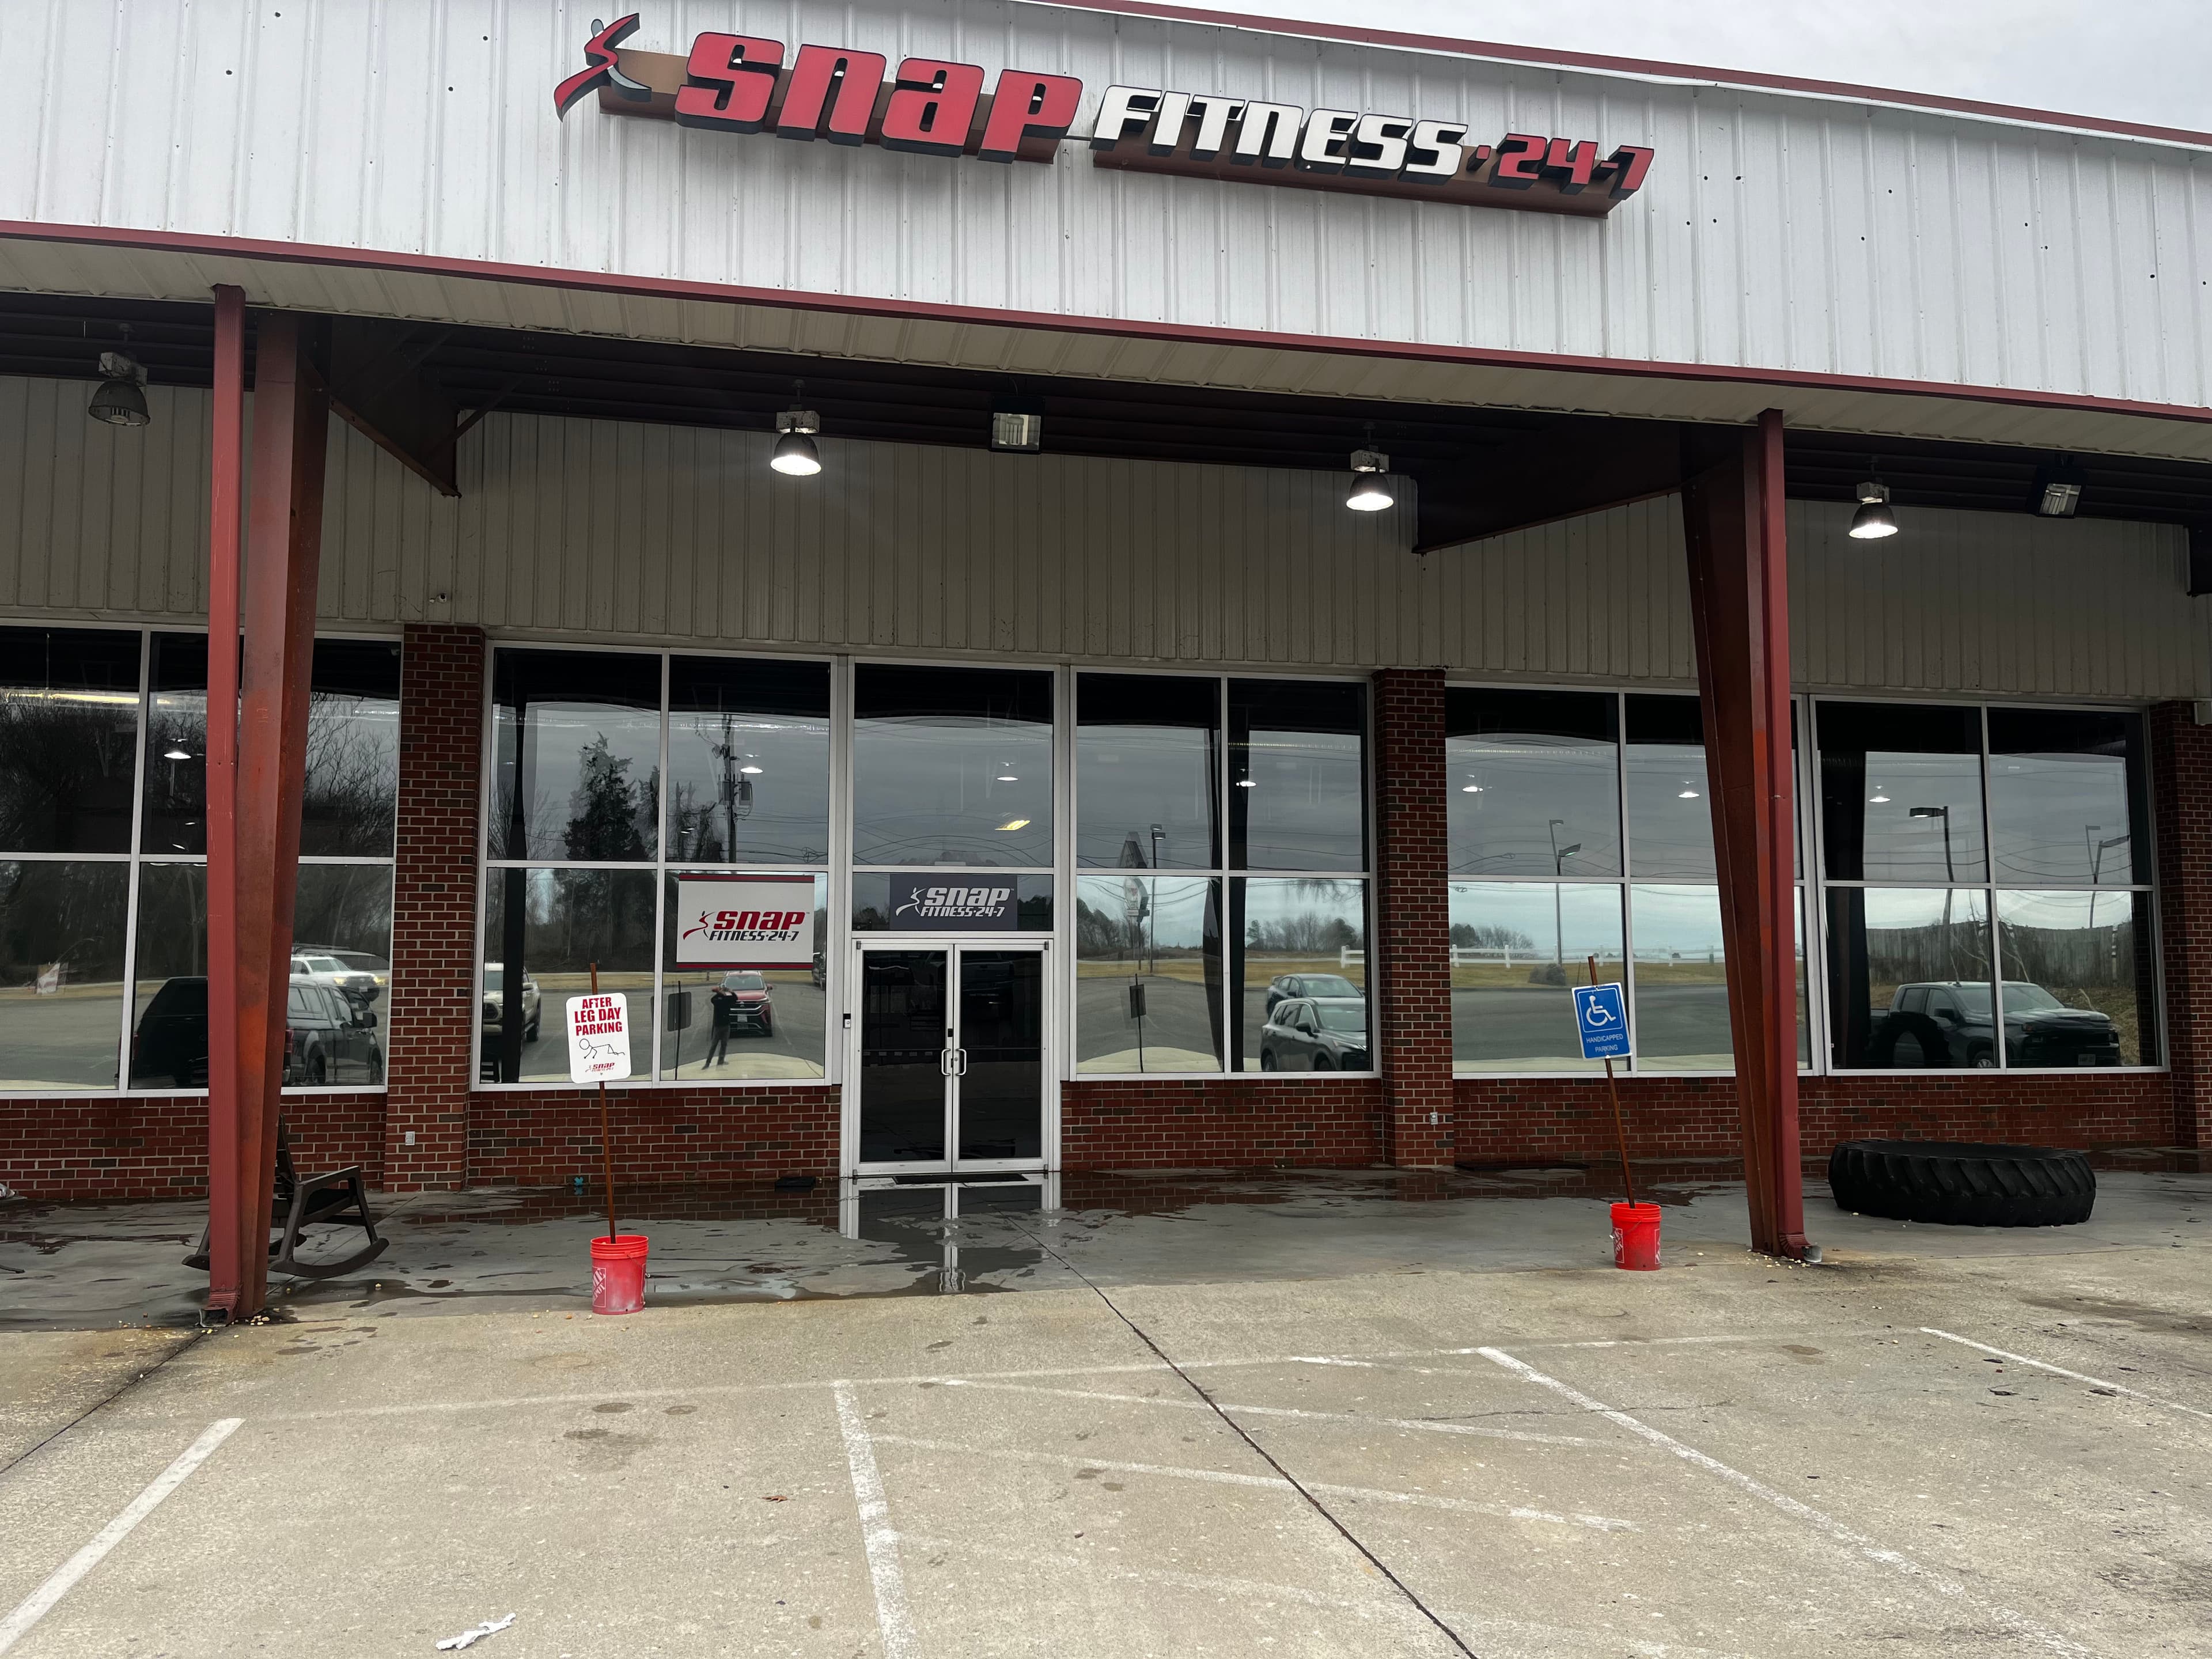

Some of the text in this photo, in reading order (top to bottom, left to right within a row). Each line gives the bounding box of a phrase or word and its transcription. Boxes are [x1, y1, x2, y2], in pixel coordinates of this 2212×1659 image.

[582, 997, 612, 1009] AFTER
[574, 1007, 622, 1024] LEG DAY
[575, 1021, 623, 1036] PARKING
[1586, 1033, 1623, 1044] HANDICAPPED
[1594, 1044, 1618, 1053] PARKING
